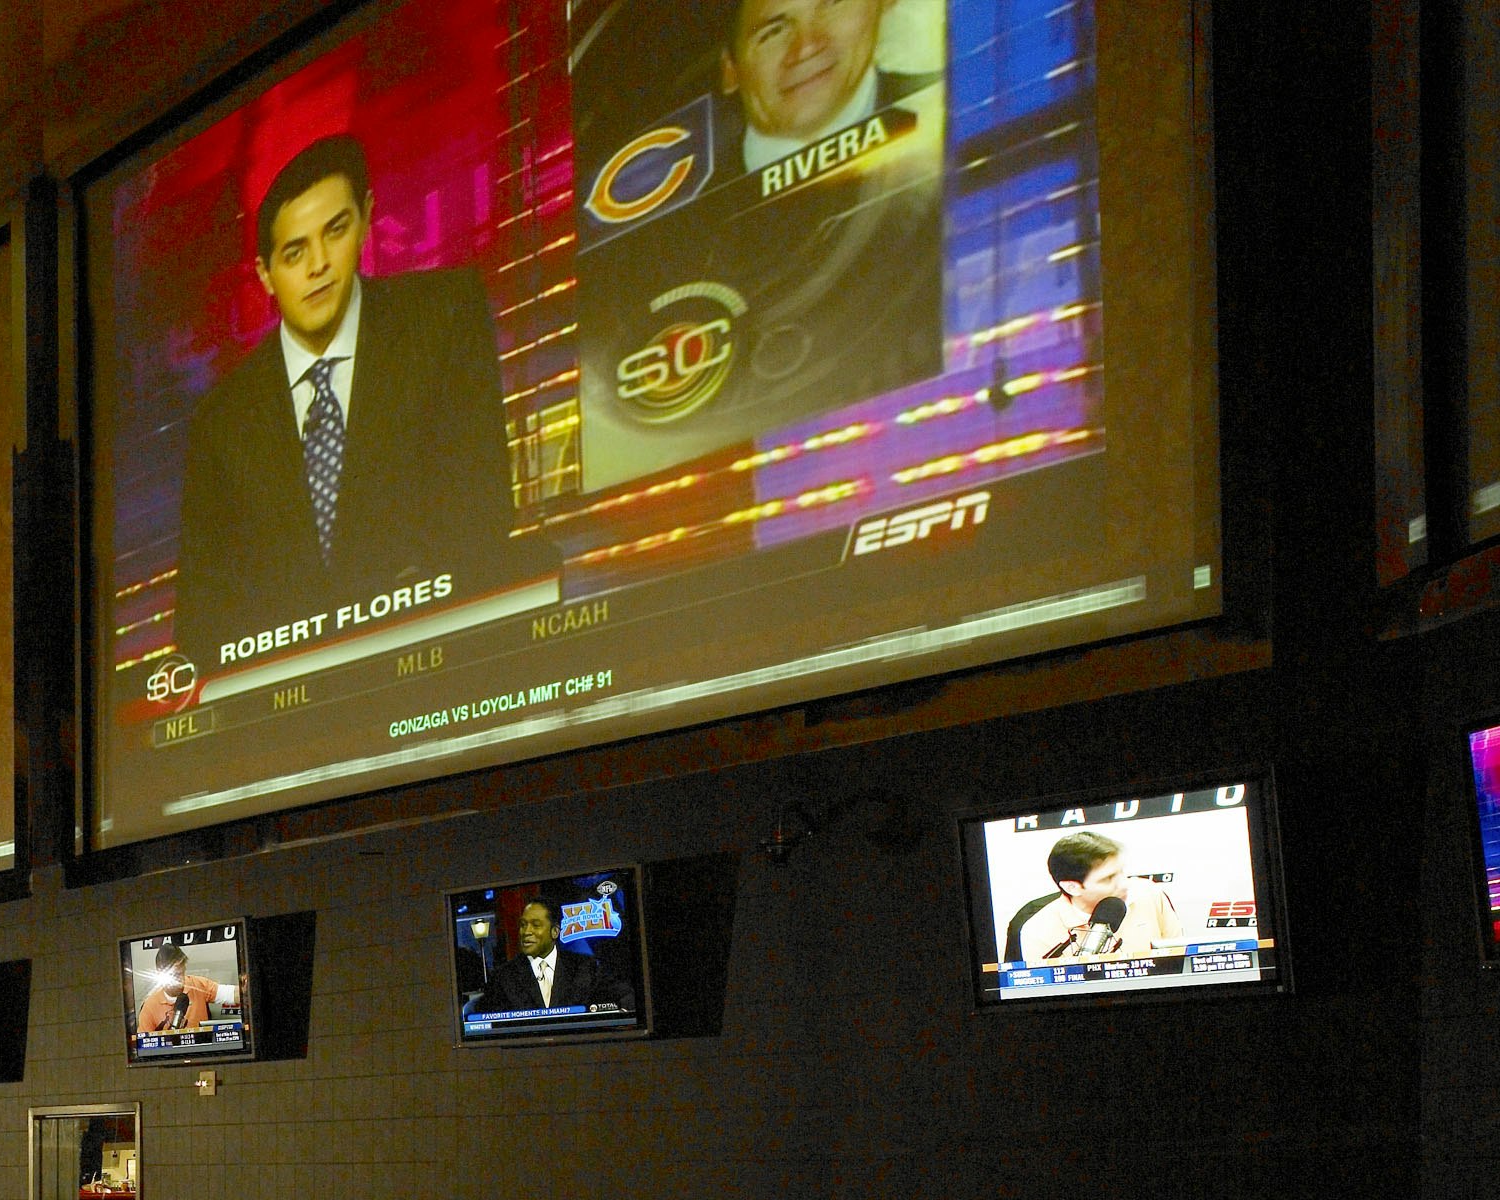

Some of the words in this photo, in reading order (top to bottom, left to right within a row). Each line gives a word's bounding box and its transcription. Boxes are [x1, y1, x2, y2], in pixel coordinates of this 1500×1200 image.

[759, 116, 889, 198] RIVERA
[615, 319, 733, 402] SC
[853, 491, 992, 555] ESPN
[219, 613, 328, 665] ROBERT
[336, 573, 453, 629] FLORES
[146, 663, 196, 702] SC
[165, 716, 198, 740] NFL
[273, 684, 311, 710] NHL
[397, 647, 443, 677] MLB
[532, 600, 610, 640] NCAAH
[389, 709, 449, 738] GONZAGA
[451, 705, 470, 723] VS
[471, 691, 527, 719] LOYOLA
[529, 681, 563, 705] MMT
[565, 674, 594, 697] CH#
[596, 669, 613, 688] 91
[1016, 783, 1246, 830] RADIO
[1068, 973, 1085, 982] FINAL
[1087, 964, 1102, 972] PHX
[1127, 969, 1133, 977] 2
[482, 1012, 510, 1020] FAVORITE
[511, 1009, 541, 1018] MOMENTS
[549, 1007, 571, 1015] MIAMI?
